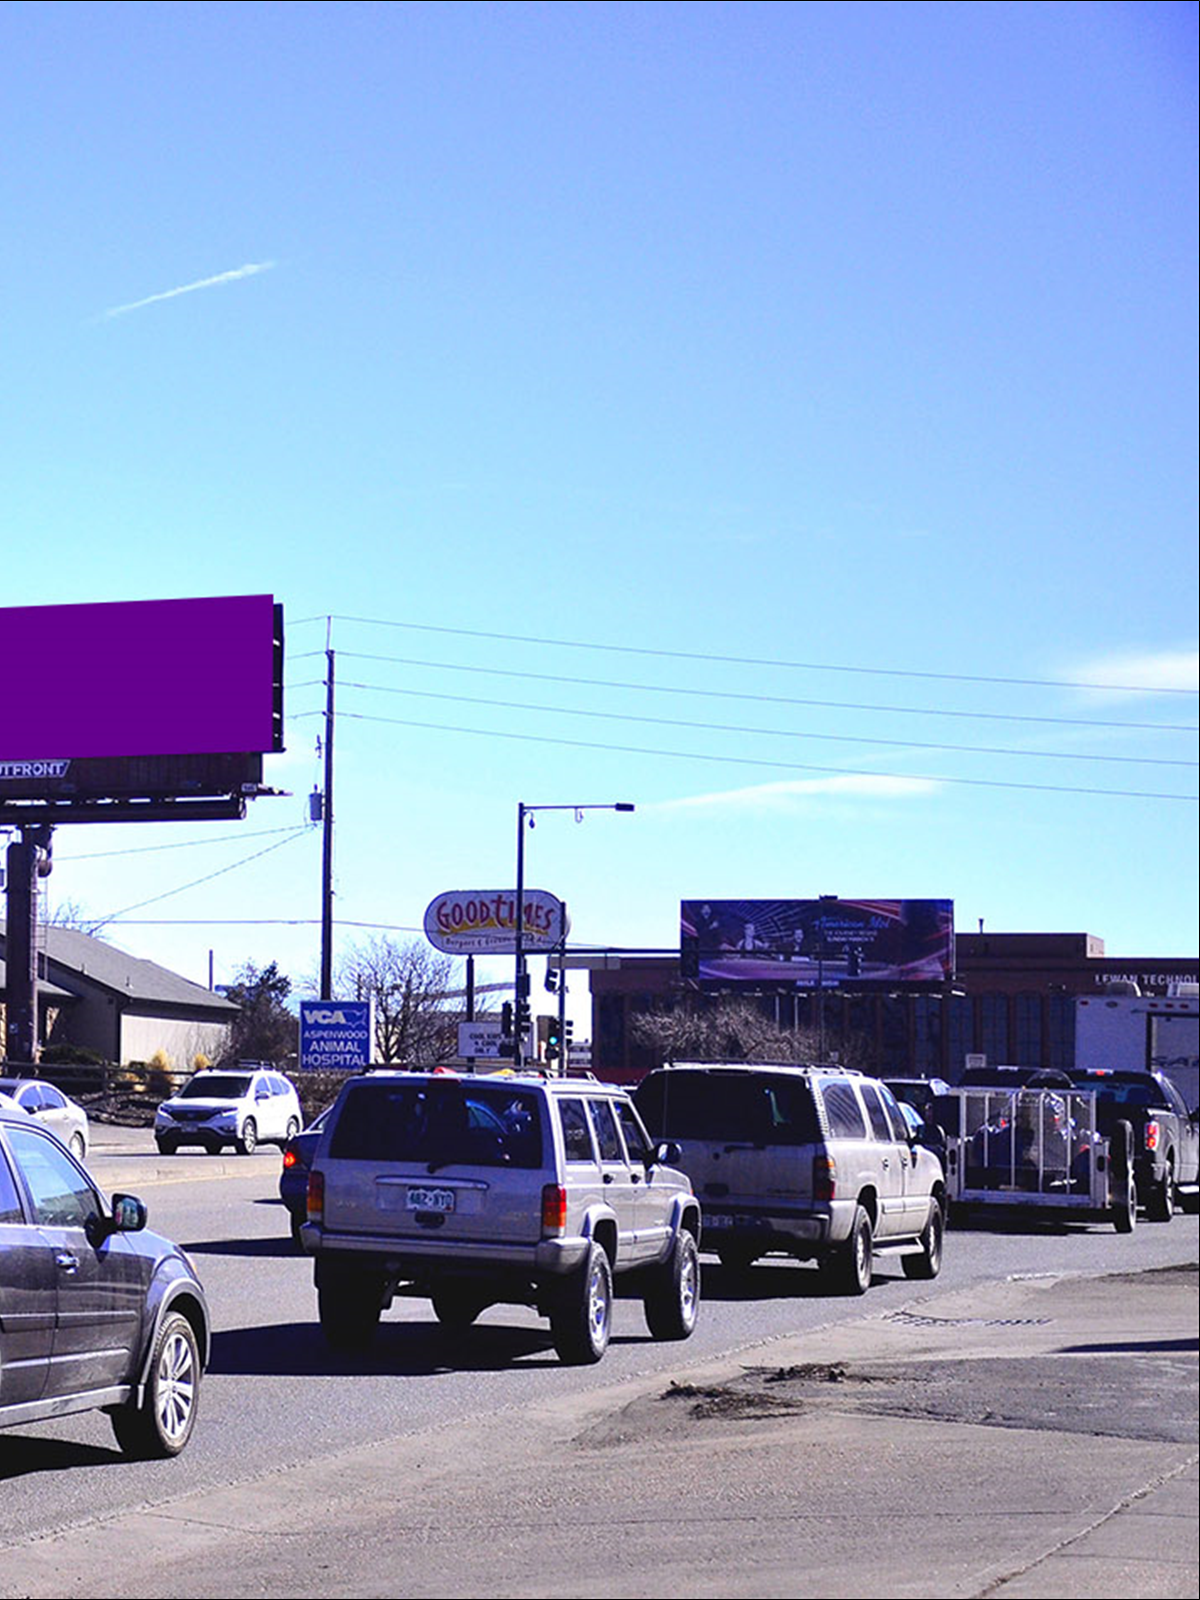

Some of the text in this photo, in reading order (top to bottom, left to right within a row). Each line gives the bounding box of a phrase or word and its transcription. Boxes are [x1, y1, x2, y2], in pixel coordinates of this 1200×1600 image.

[303, 1009, 346, 1024] VCA
[303, 1030, 368, 1039] ASPENWOOD
[309, 1041, 361, 1052] ANIMAL
[302, 1053, 366, 1066] HOSPITAL
